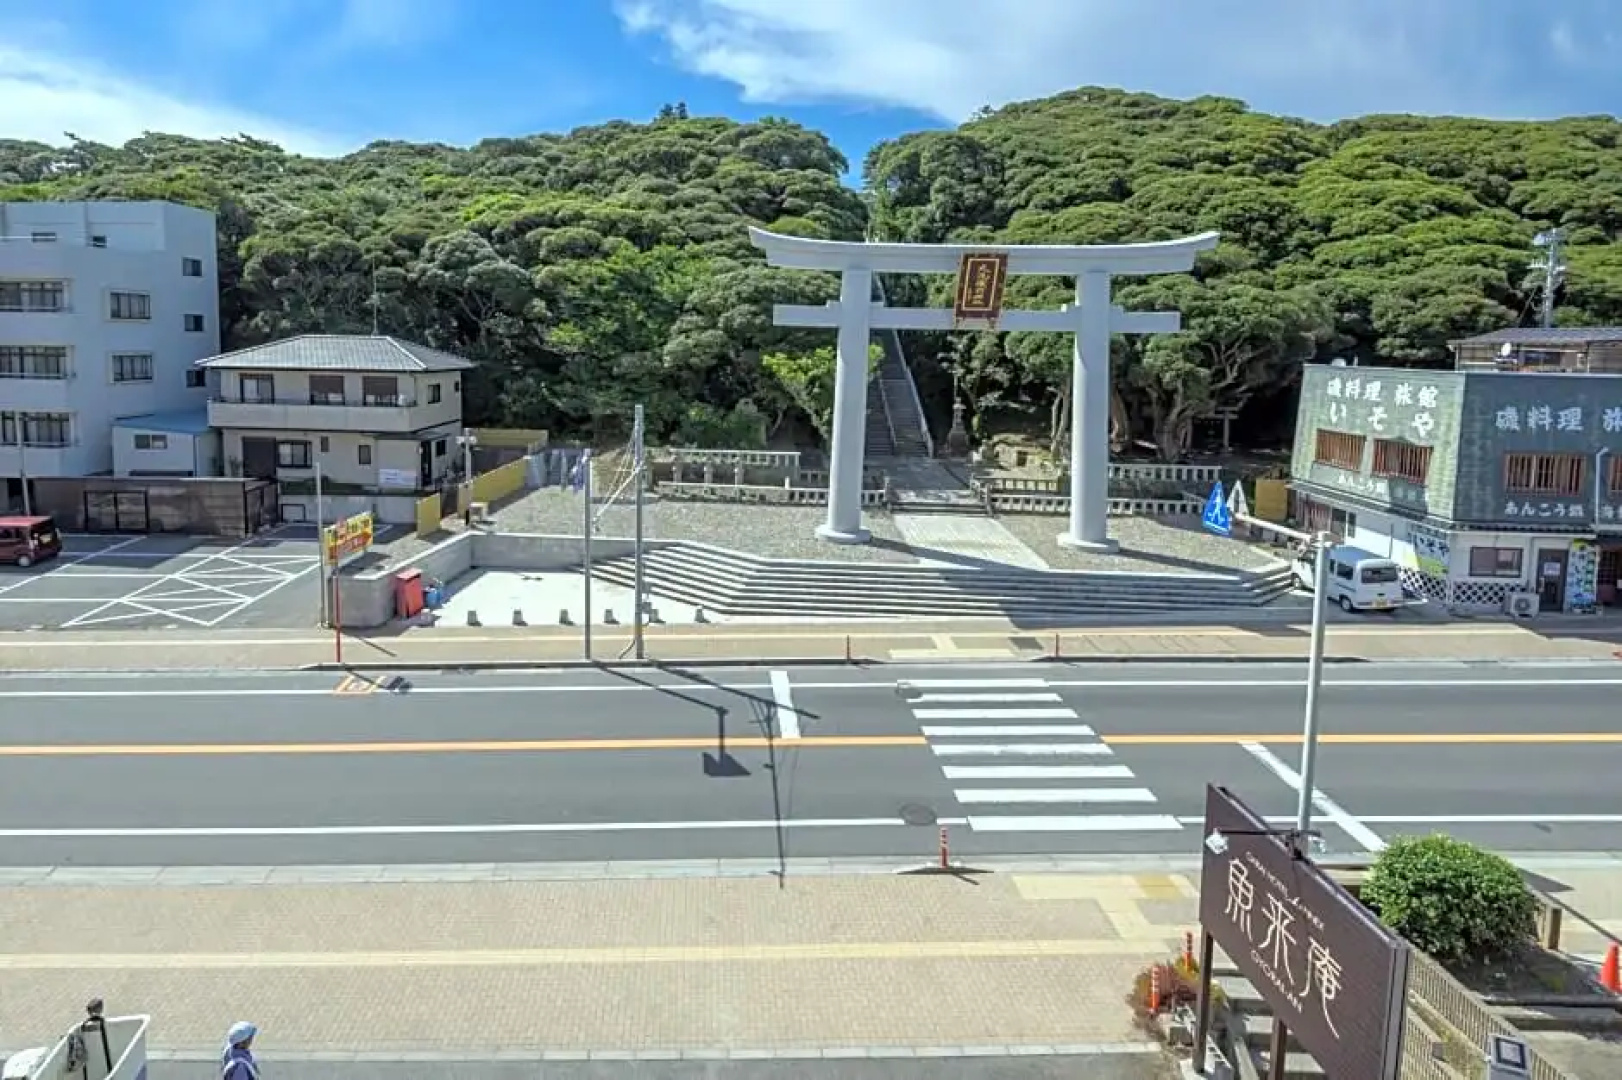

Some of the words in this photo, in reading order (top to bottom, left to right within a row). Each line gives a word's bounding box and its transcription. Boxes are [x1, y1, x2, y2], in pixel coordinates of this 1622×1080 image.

[1330, 401, 1435, 437] いそや
[1495, 404, 1584, 431] 磯料理
